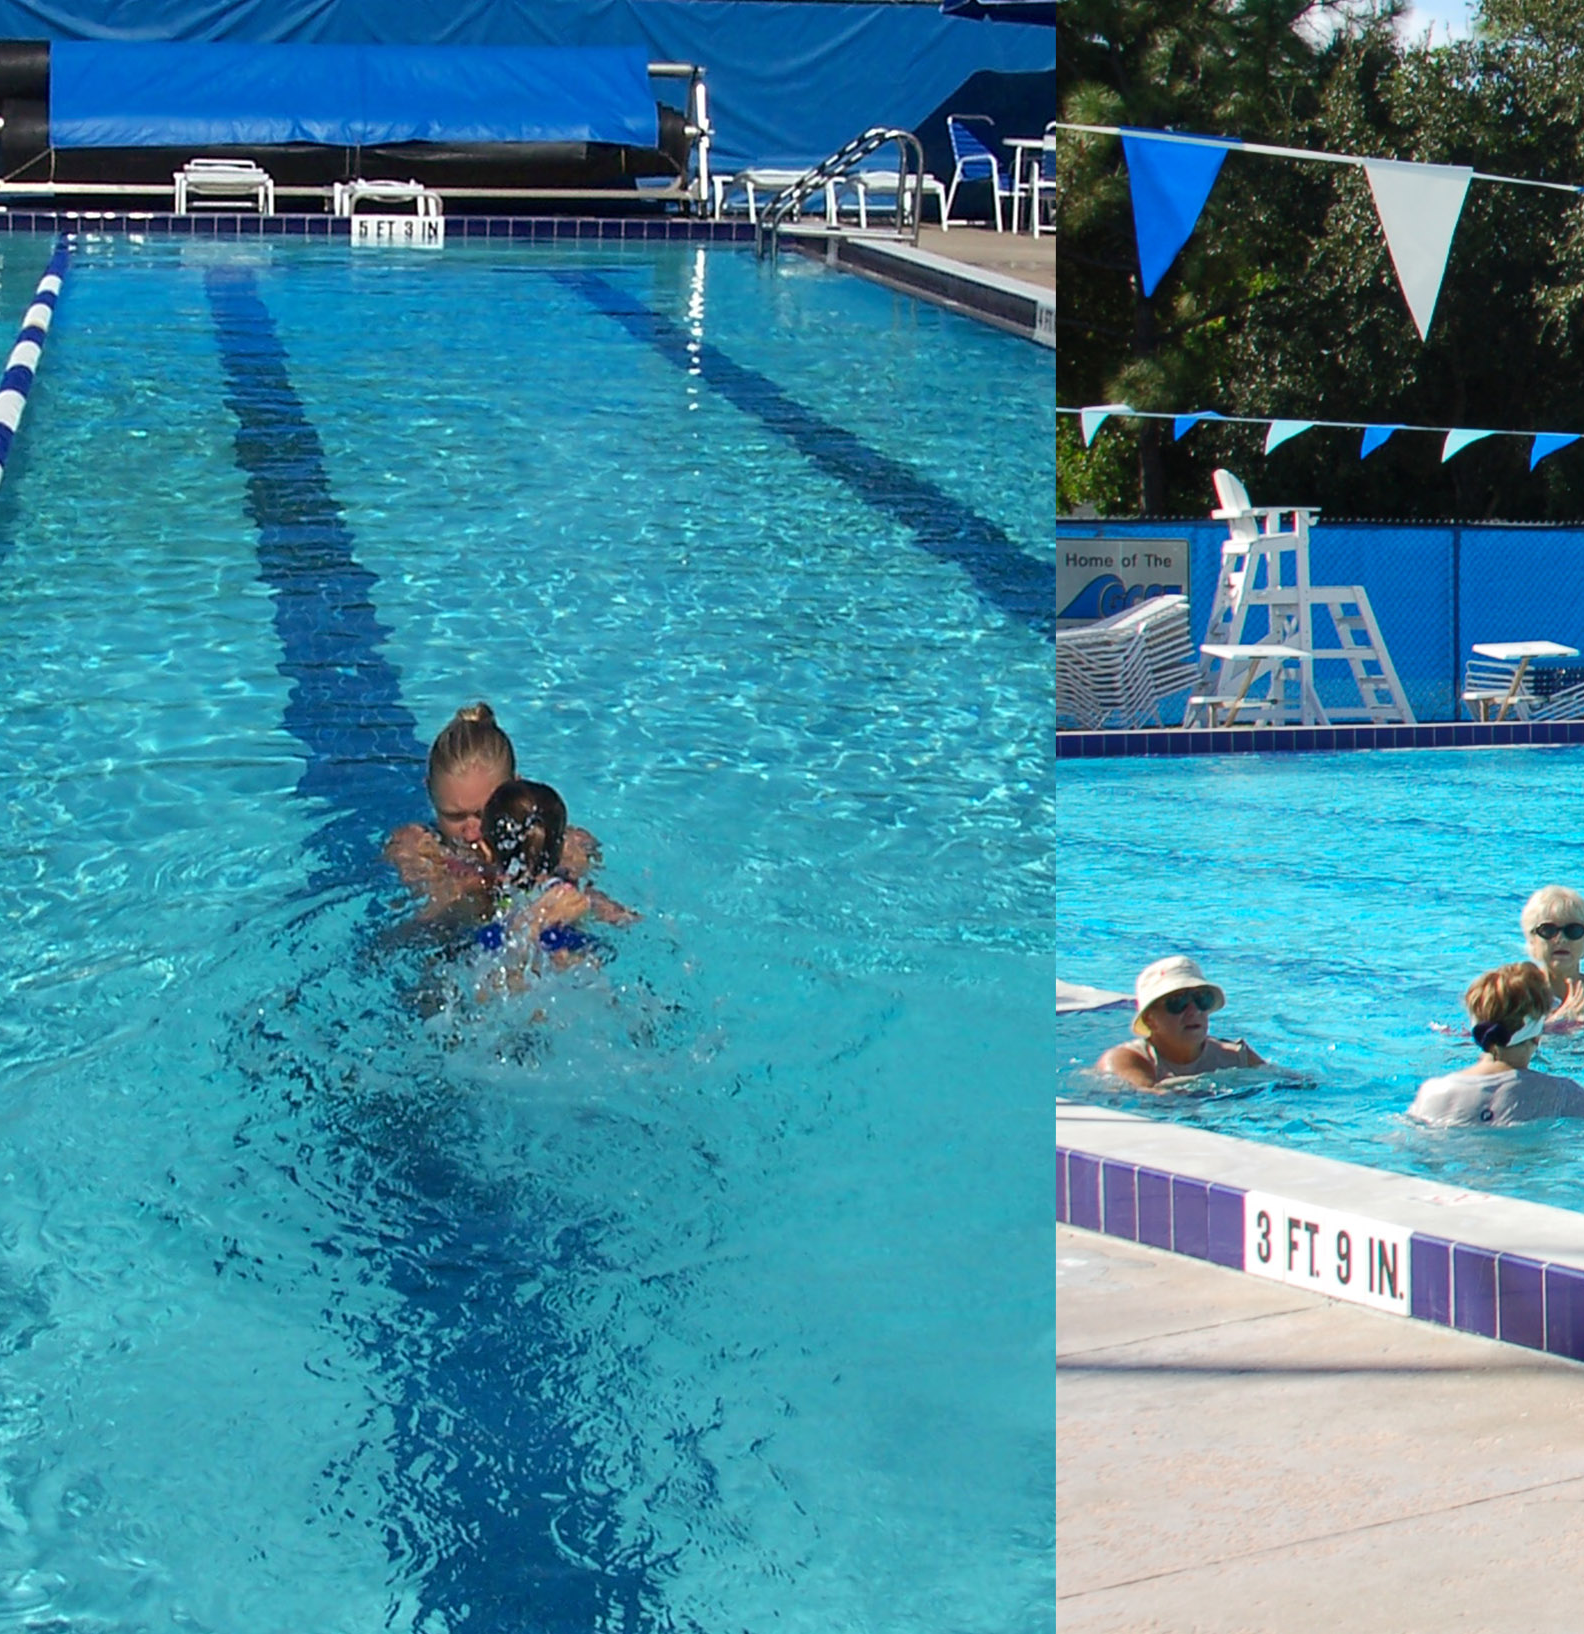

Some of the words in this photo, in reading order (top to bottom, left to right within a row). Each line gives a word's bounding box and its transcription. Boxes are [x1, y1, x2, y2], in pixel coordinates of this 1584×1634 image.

[404, 220, 413, 239] 3
[1065, 553, 1113, 567] Home
[1121, 554, 1137, 567] of
[1144, 553, 1172, 568] The
[1257, 1210, 1271, 1264] 3
[1287, 1216, 1320, 1278] FT.
[1336, 1230, 1351, 1285] 9
[1368, 1236, 1404, 1300] IN.
